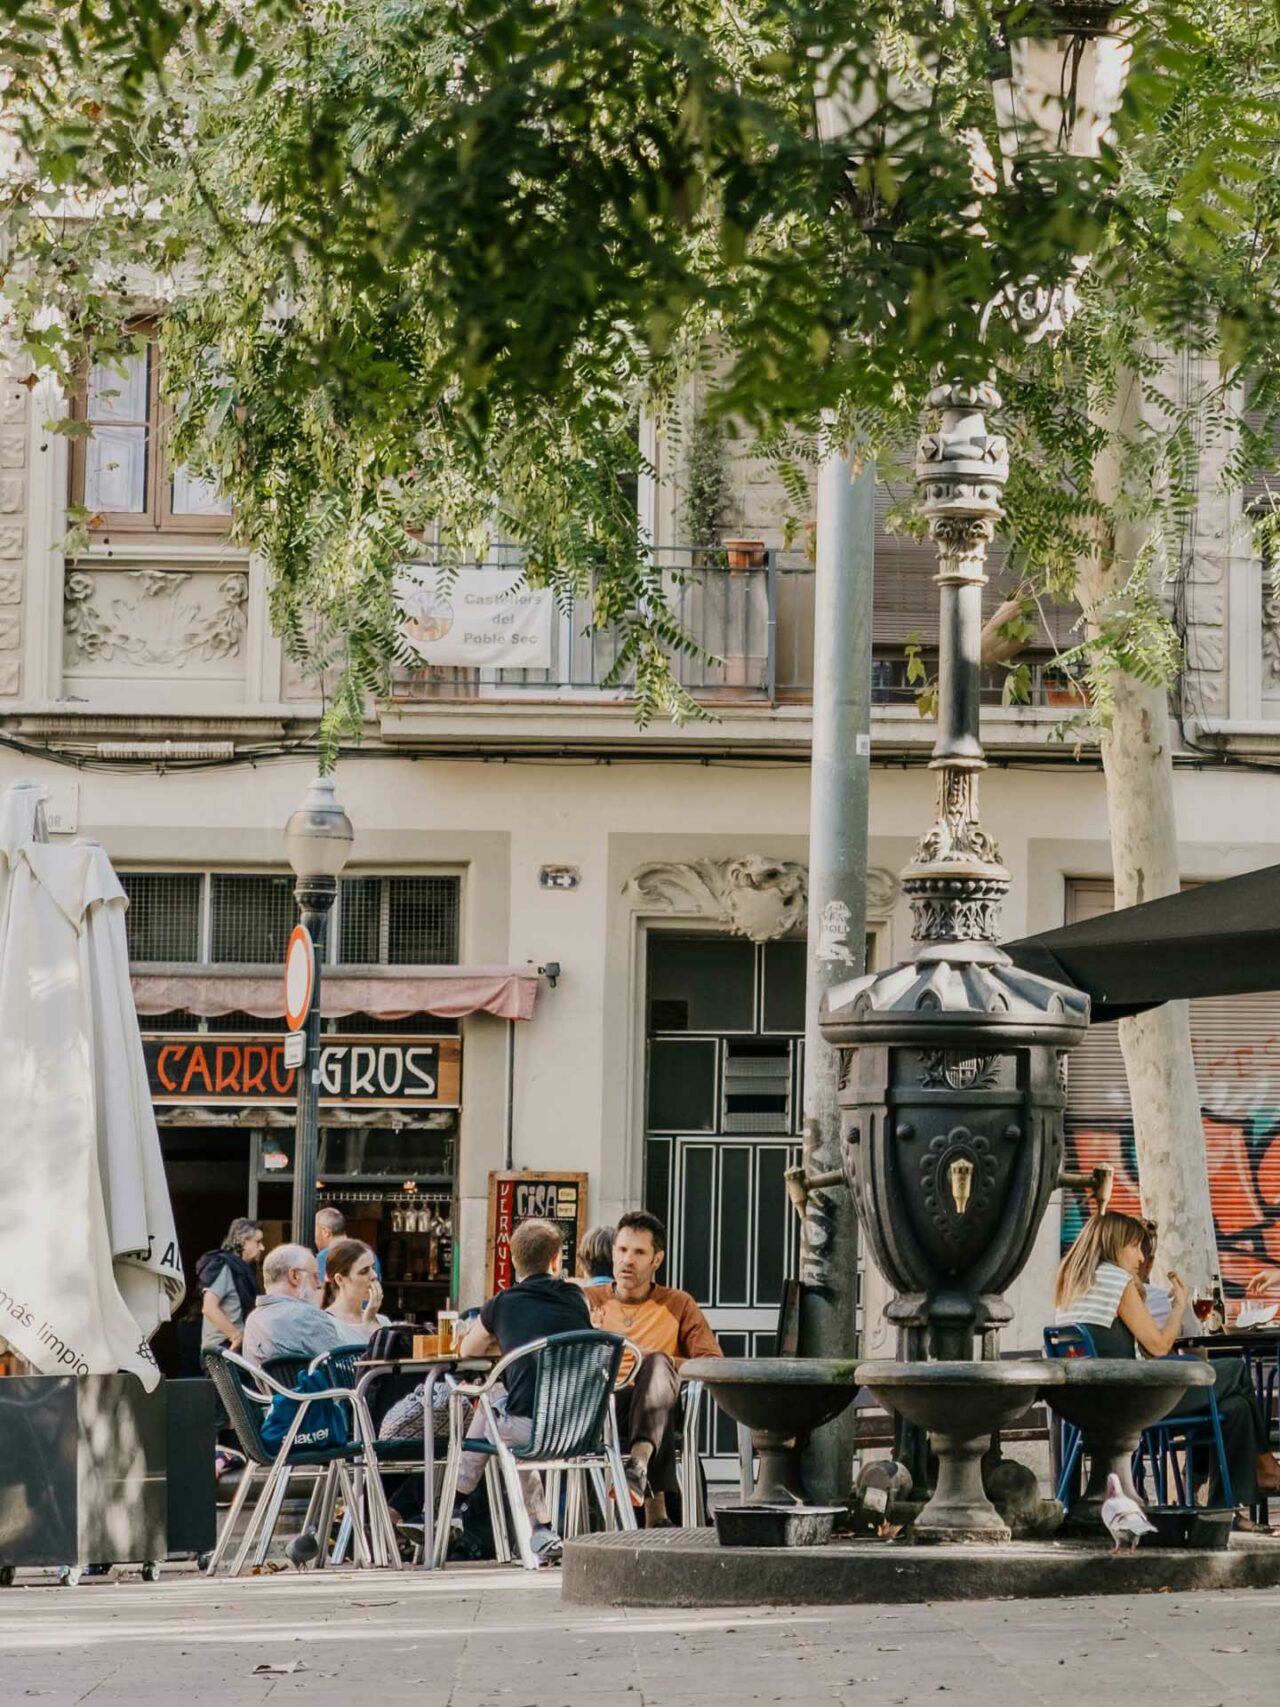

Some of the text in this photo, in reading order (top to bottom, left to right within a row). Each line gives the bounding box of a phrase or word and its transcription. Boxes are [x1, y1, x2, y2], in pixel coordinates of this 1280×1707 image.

[464, 592, 542, 605] Castllers
[492, 613, 515, 625] del
[464, 632, 538, 645] Poble Sec
[157, 1045, 296, 1093] CARRO
[319, 1047, 436, 1095] GROS
[36, 1322, 90, 1377] limpio
